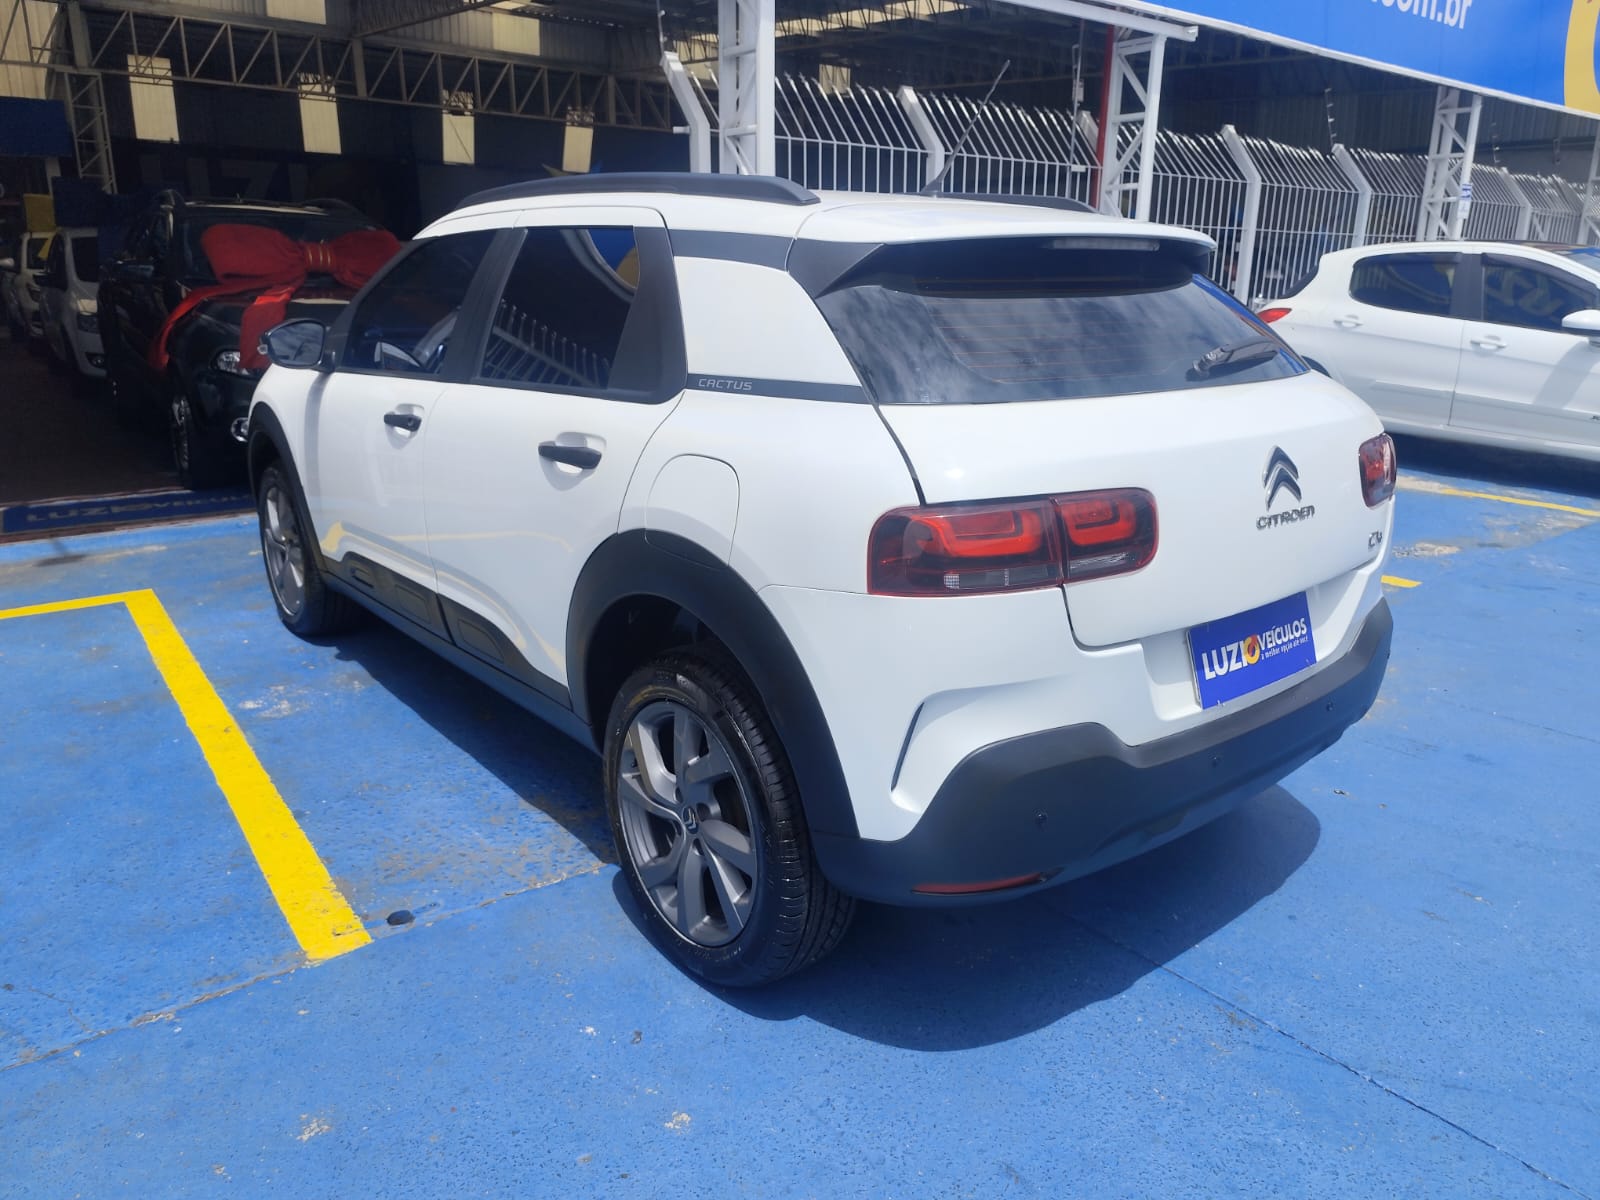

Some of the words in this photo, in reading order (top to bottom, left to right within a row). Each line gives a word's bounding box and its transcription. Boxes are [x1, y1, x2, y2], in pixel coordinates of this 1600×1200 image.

[698, 378, 753, 391] CACTUS
[1201, 633, 1261, 681] LUZIO
[1257, 617, 1307, 651] VEÍCULOS
